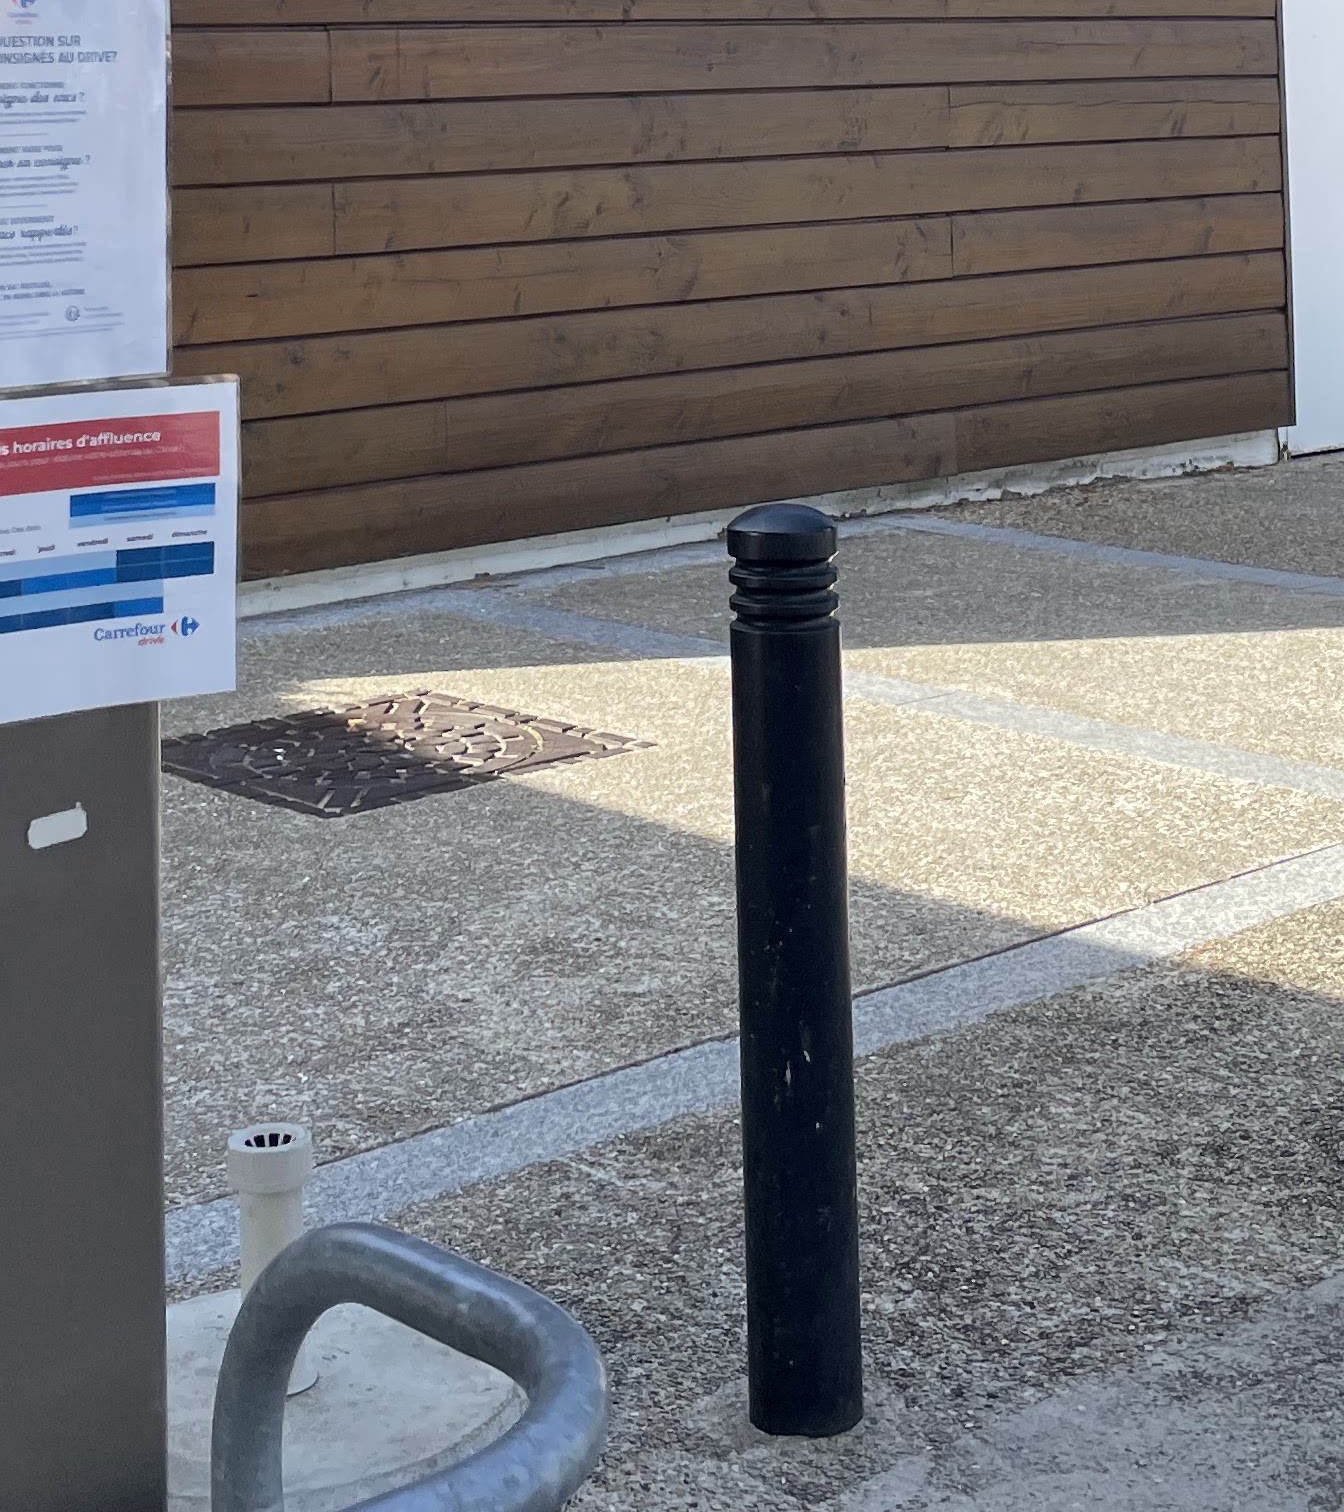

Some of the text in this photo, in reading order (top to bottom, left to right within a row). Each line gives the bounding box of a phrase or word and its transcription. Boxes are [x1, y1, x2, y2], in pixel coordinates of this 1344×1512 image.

[57, 35, 81, 47] SUR
[58, 51, 75, 63] AU
[12, 437, 73, 454] horaires
[76, 431, 161, 448] d'affluence
[94, 623, 166, 641] Carrefour
